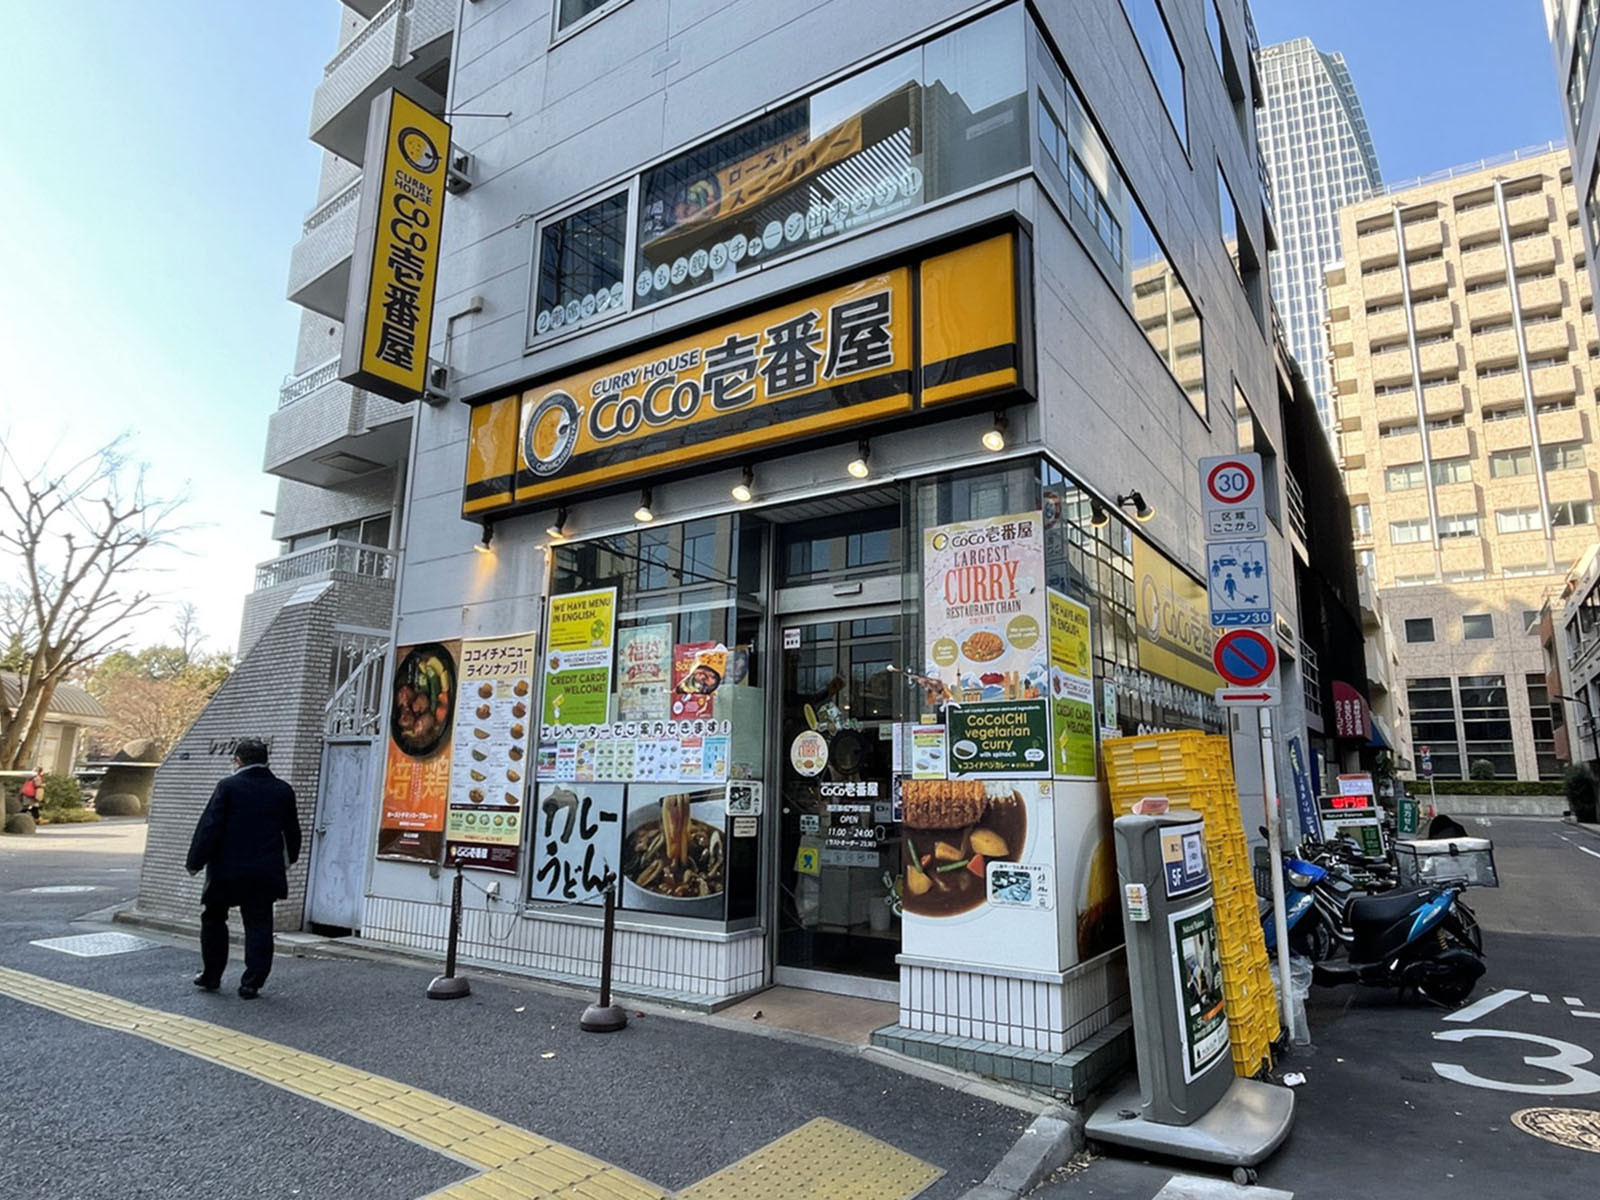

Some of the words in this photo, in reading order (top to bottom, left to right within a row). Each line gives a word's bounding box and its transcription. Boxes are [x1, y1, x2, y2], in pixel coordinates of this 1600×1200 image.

[395, 169, 433, 195] CURRY
[394, 178, 432, 207] HOUSE
[375, 193, 431, 372] CoCo壱番屋
[588, 290, 894, 441] CoCo壱番屋
[591, 368, 641, 397] CURRY
[642, 350, 699, 380] HOUSE
[1218, 473, 1245, 492] 30
[1221, 511, 1246, 521] 区域
[952, 521, 1033, 548] CoCo壱番屋
[1213, 521, 1257, 532] ここから
[954, 545, 1010, 567] LARGEST
[943, 560, 1020, 605] CURRY
[553, 603, 565, 612] WE
[567, 600, 587, 610] HAVE
[588, 597, 611, 608] MENU
[946, 603, 994, 619] RESTAURANT
[995, 600, 1022, 613] CHAIN
[553, 613, 561, 622] IN
[464, 647, 532, 661] ココイチメニュー
[467, 660, 528, 677] ラインナップ!!
[551, 674, 577, 686] CREDIT
[579, 672, 606, 684] CARDS
[967, 713, 1028, 727] CoCoICHI
[965, 726, 1031, 740] vegetarian
[982, 739, 1014, 752] curry
[993, 750, 1017, 759] spinach
[821, 782, 878, 797] CoCo壱番屋
[543, 785, 618, 844] カレー
[840, 815, 859, 824] OPEN
[537, 841, 610, 899] うどん
[1172, 867, 1182, 887] 5F
